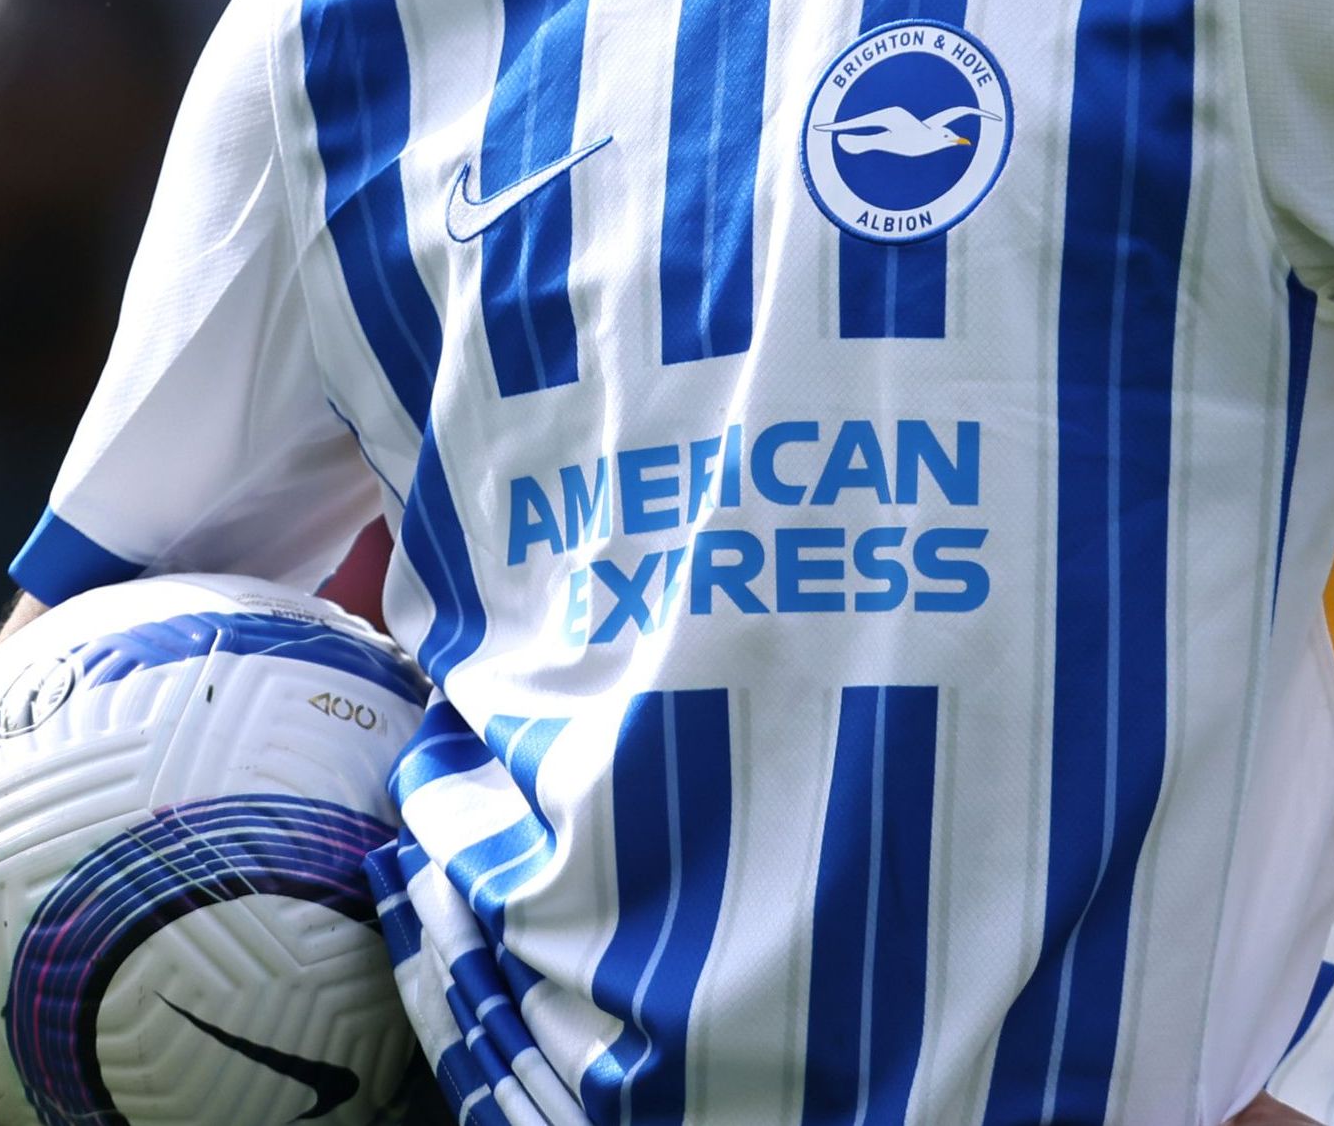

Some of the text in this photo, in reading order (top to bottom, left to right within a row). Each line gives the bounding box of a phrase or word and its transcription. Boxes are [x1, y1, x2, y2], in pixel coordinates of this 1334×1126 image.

[832, 30, 994, 89] BRIGHTON & HOVE
[856, 210, 933, 233] ALBION
[506, 418, 981, 567] AMERICAN
